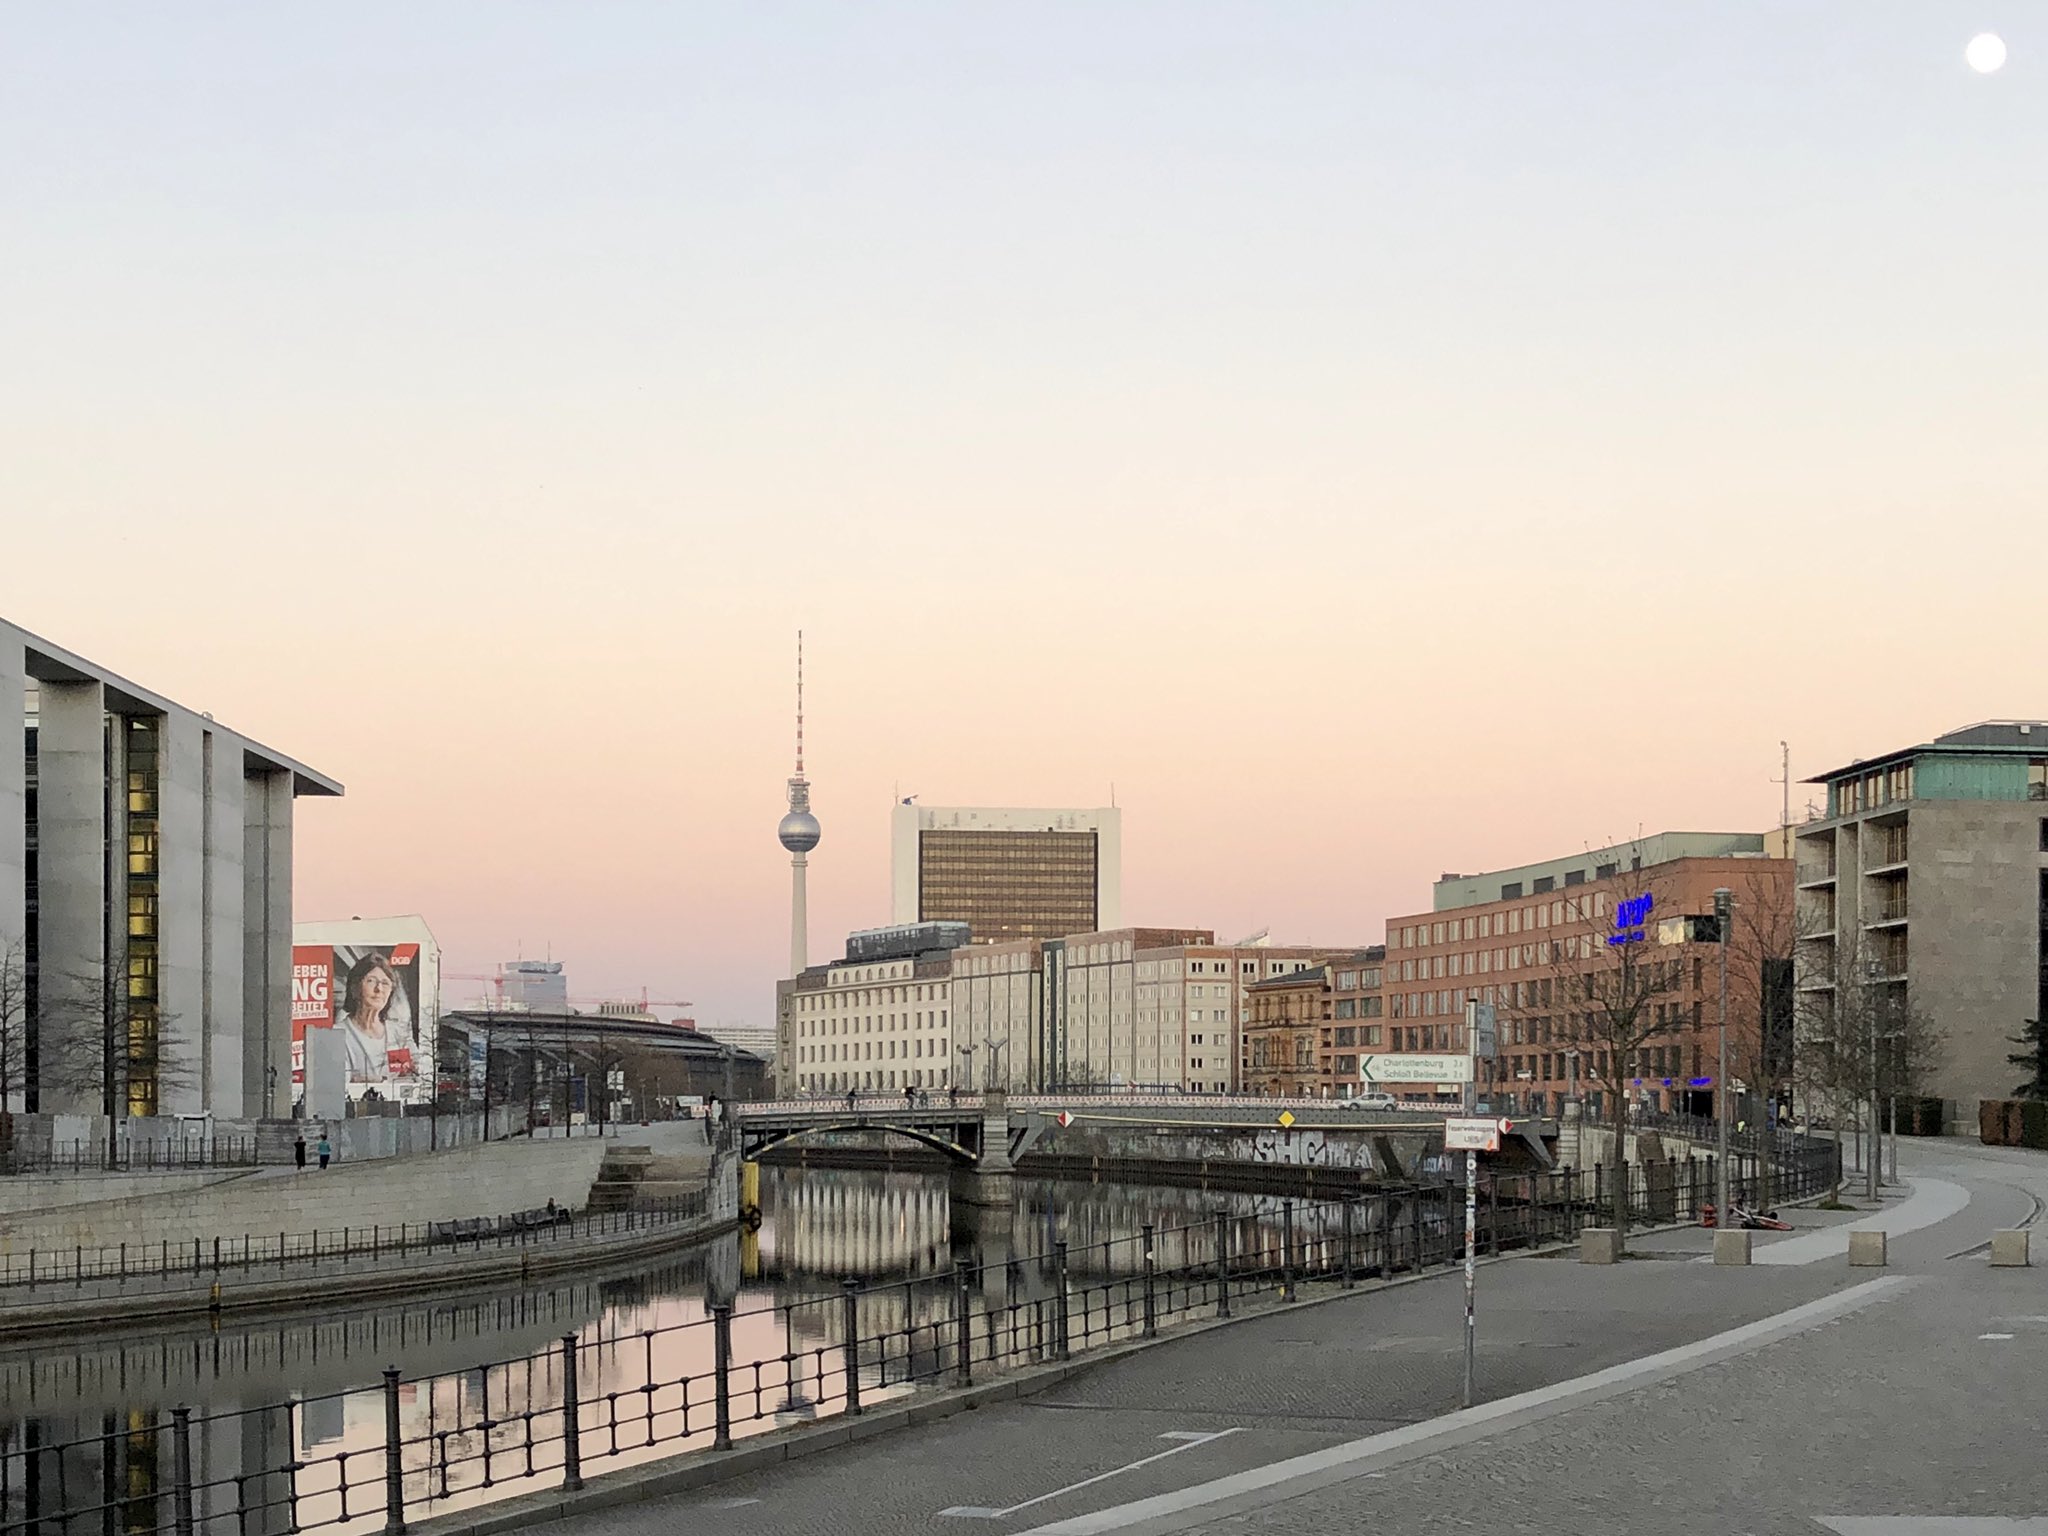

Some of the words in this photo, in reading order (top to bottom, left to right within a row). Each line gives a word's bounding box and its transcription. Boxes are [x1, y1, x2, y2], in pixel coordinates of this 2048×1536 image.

[391, 956, 411, 965] DGB
[292, 977, 328, 1001] NG
[1383, 1058, 1444, 1069] Charlottenburg
[1413, 1069, 1448, 1079] Bellevue
